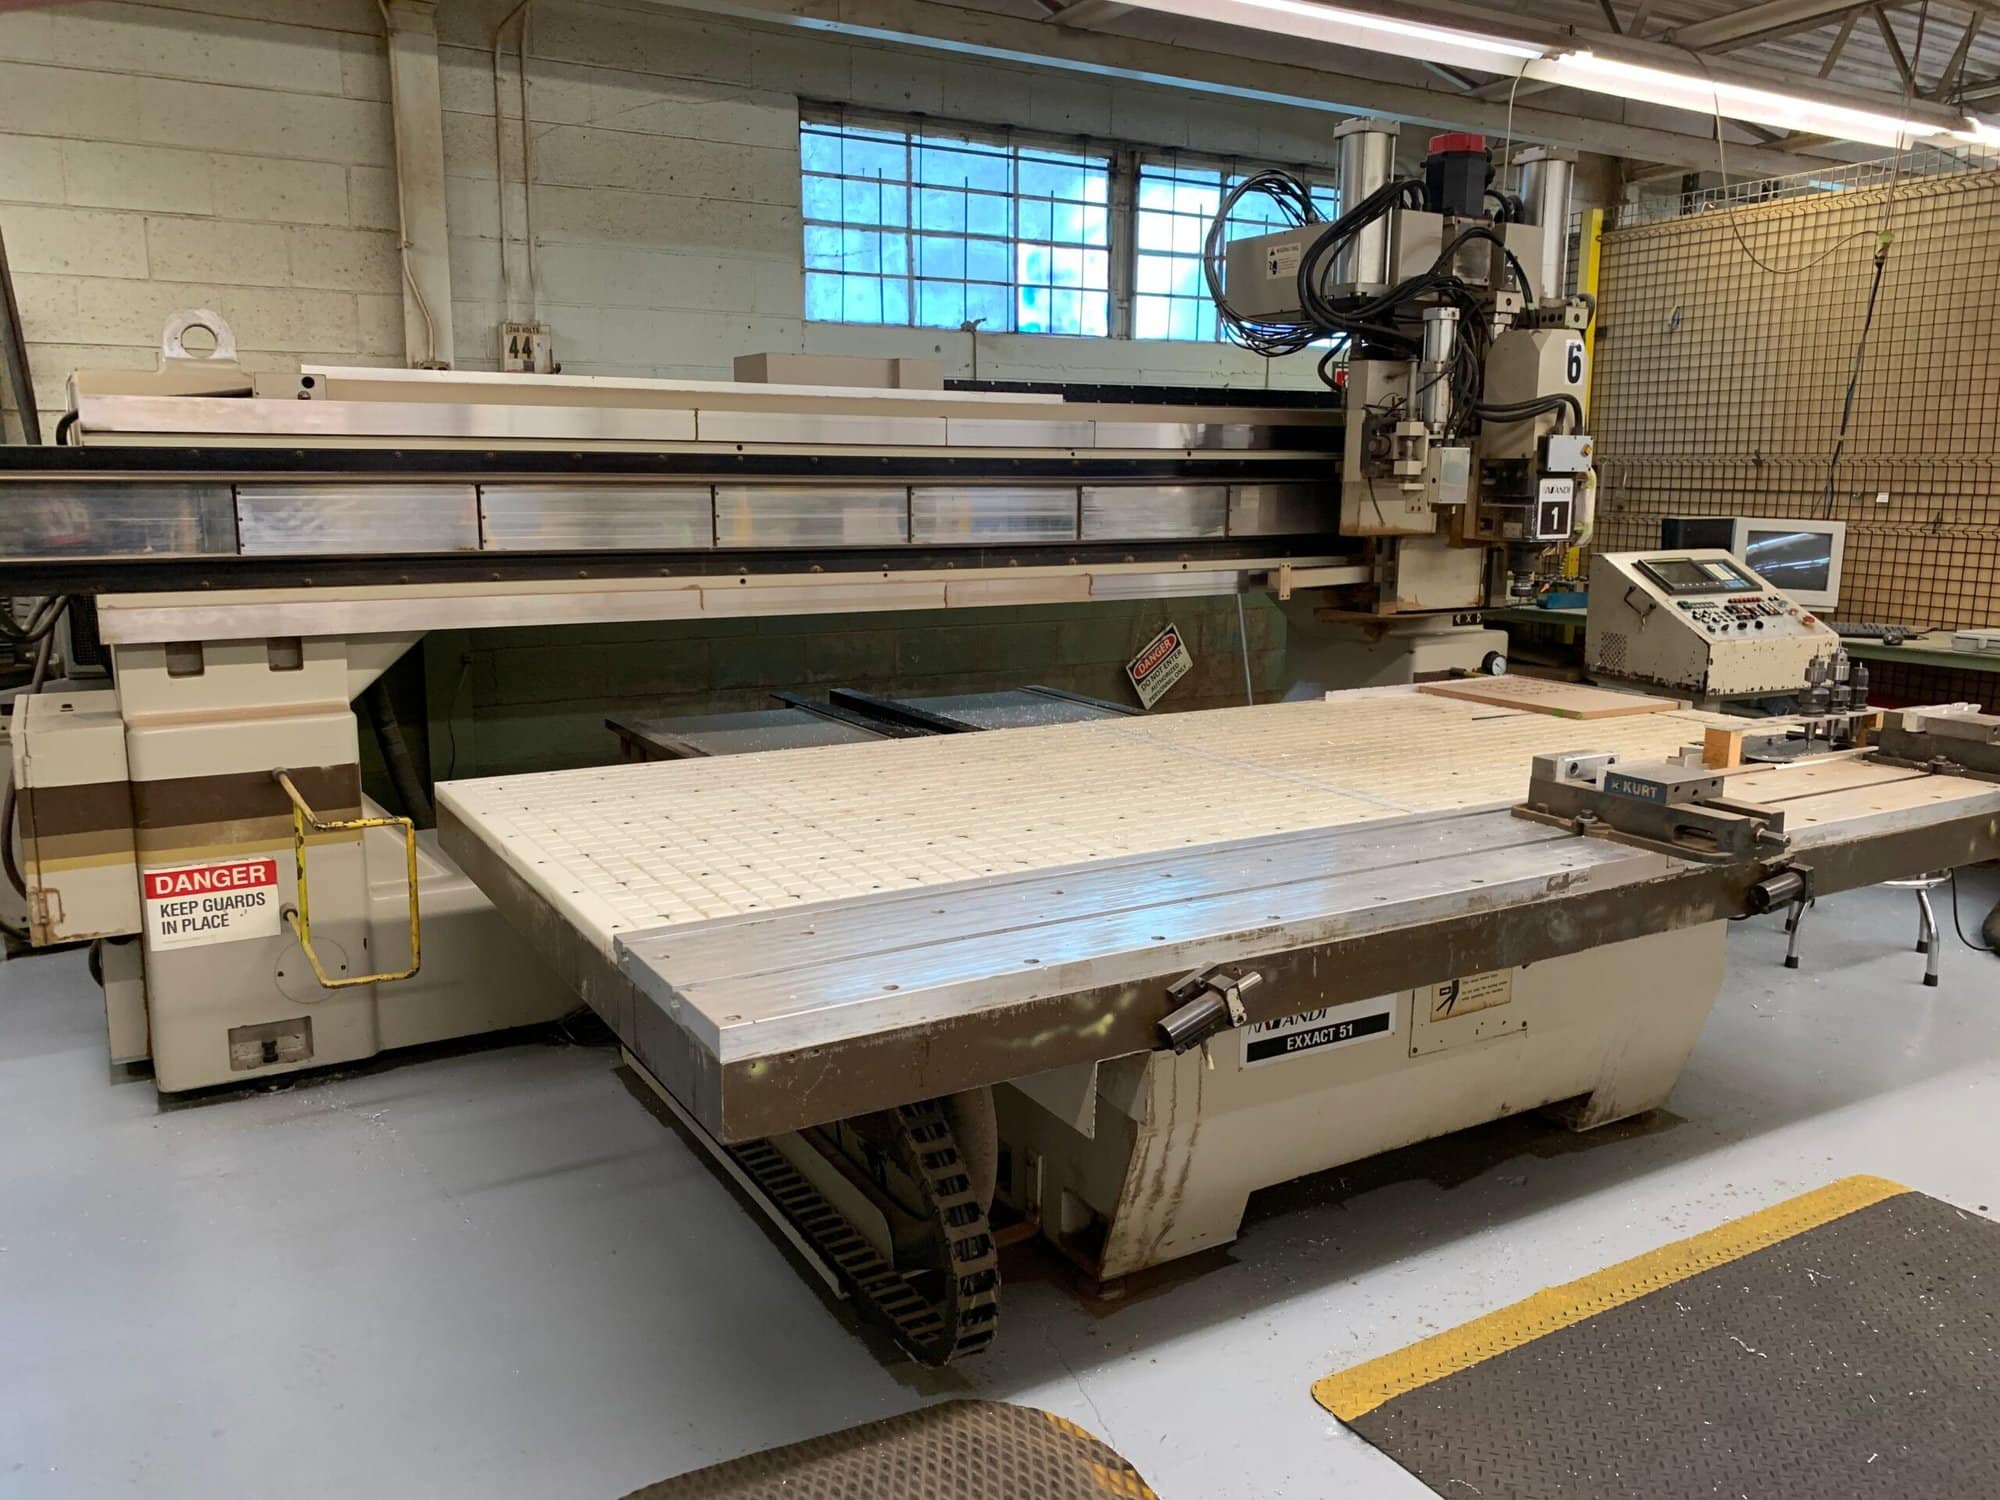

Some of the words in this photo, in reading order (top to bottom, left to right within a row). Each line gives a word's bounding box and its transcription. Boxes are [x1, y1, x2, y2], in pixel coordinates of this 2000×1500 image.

[509, 335, 532, 359] 44
[1567, 343, 1582, 384] 6
[1551, 506, 1559, 530] 1
[1138, 639, 1171, 674] DANGER
[1141, 679, 1151, 691] DO
[1150, 667, 1163, 681] NOT
[1163, 649, 1183, 669] ENTER
[1174, 665, 1186, 679] ONLY
[1623, 780, 1658, 798] KURT
[155, 865, 267, 895] DANGER
[160, 900, 199, 918] KEEP
[203, 892, 266, 913] GUARDS
[161, 920, 178, 935] IN
[182, 913, 230, 933] PLACE
[1286, 1028, 1336, 1051] EXXACT
[1339, 1023, 1354, 1039] 51
